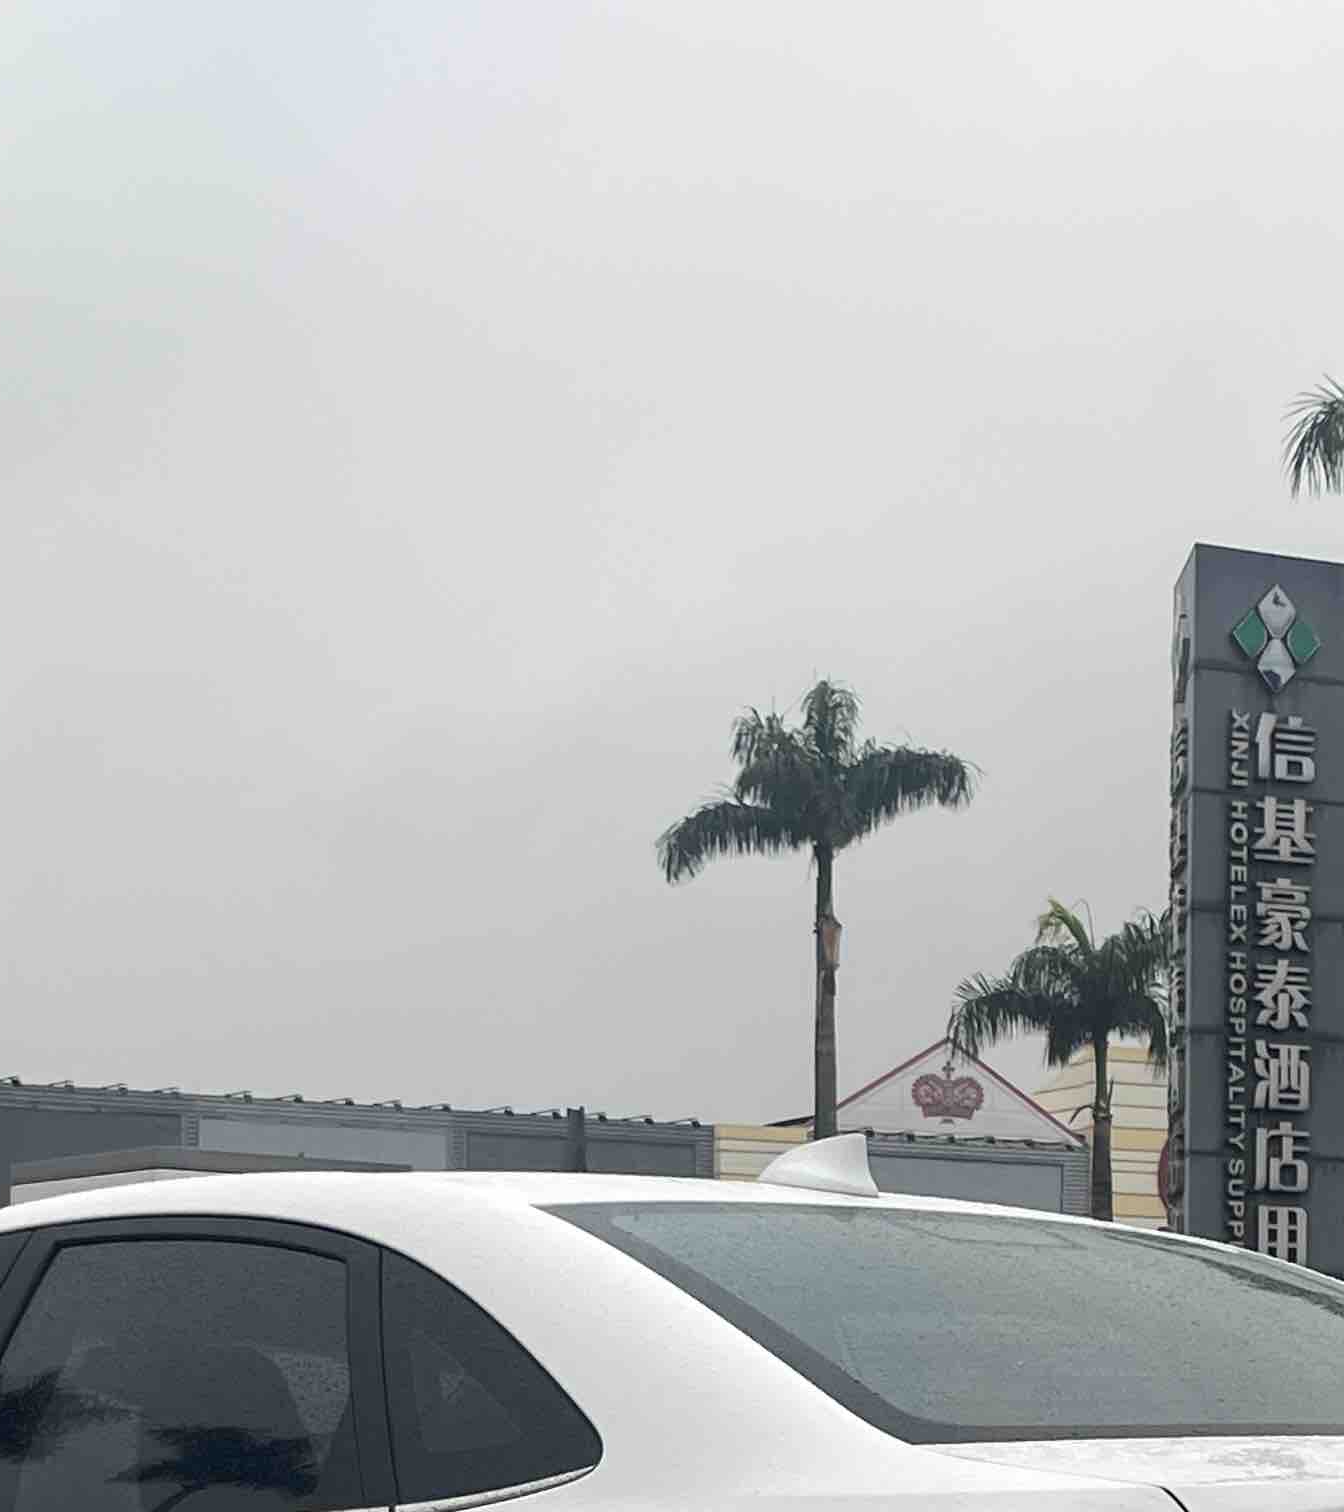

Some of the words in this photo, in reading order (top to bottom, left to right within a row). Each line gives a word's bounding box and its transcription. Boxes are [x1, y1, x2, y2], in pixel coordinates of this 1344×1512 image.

[1230, 707, 1250, 787] XINJI
[1229, 801, 1249, 942] HOTELEX
[1228, 951, 1248, 1147] HOSPITALITY
